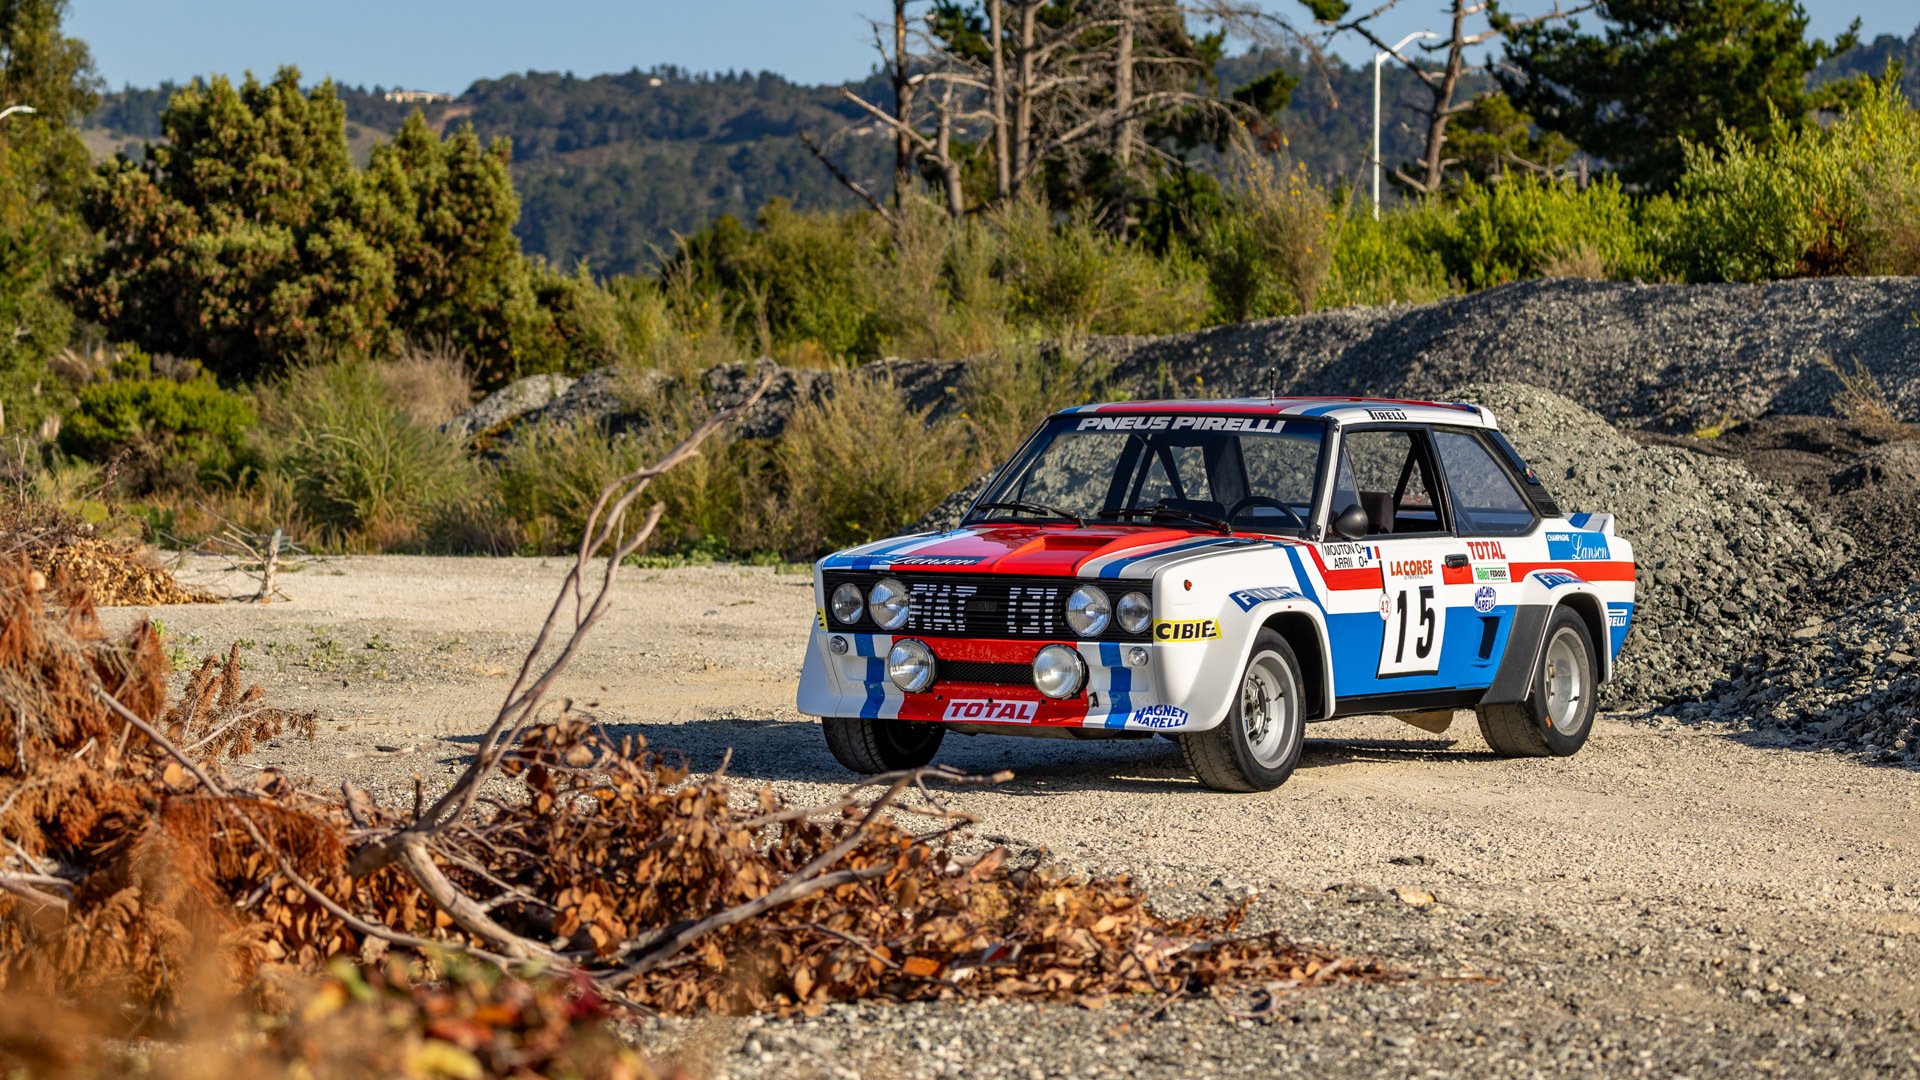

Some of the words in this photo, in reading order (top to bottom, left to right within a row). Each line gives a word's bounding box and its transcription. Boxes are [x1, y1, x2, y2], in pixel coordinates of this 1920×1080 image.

[1362, 407, 1407, 420] PIRELLI
[1076, 416, 1173, 431] PNEUS
[1171, 416, 1286, 433] PIRELLI
[1324, 543, 1356, 556] MOUTON
[1467, 541, 1506, 560] TOTAL
[1571, 533, 1609, 560] Lanson
[908, 584, 977, 631] FIAT
[1007, 587, 1058, 633] 131
[1381, 600, 1389, 613] 42
[1395, 585, 1436, 663] 15
[1608, 609, 1627, 627] PRELLI
[950, 702, 1035, 720] TOTAL
[1133, 704, 1189, 721] MAGNETI
[1133, 714, 1189, 728] MARELLI
